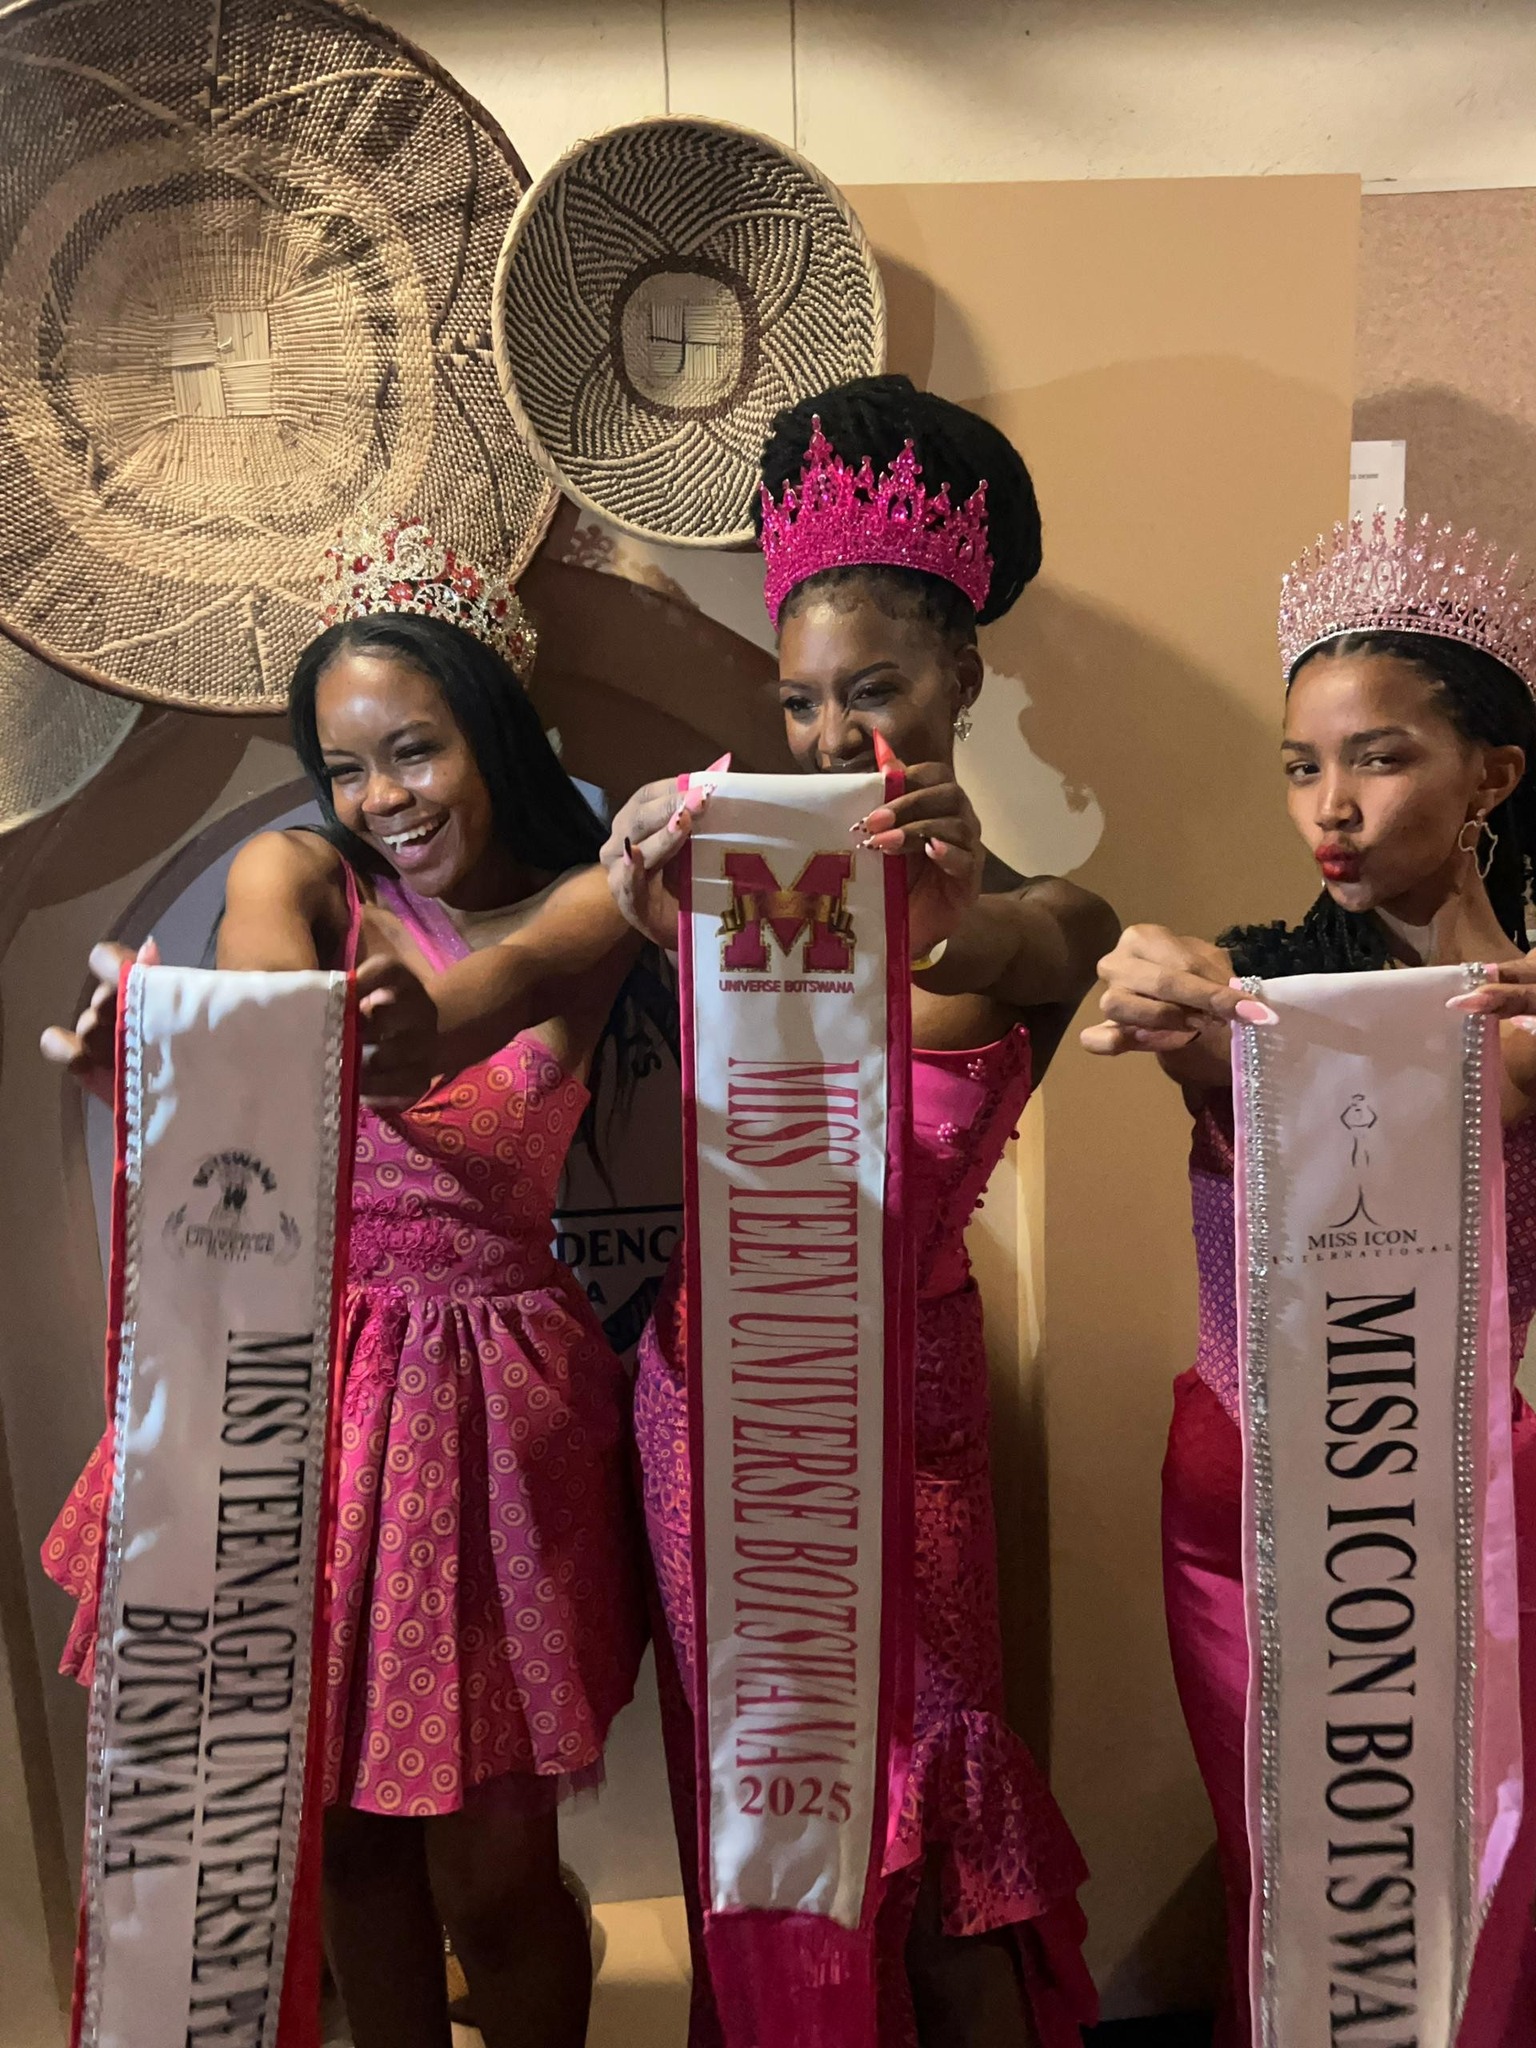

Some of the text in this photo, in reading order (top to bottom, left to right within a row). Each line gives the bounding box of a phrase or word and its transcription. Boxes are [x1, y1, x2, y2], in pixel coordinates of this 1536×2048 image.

[718, 979, 855, 994] UNIVERSE BOTSWANA
[557, 1225, 678, 1268] DENC
[1272, 1243, 1454, 1265] INTERNATIONAL
[1307, 1229, 1418, 1251] MISS ICON
[220, 1330, 315, 1447] MISS
[725, 1057, 861, 1770] MISS TEEN UNIVERSE BOTSWANA
[207, 1457, 306, 1720] TEENAGER
[1324, 1287, 1419, 2048] MISS ICON BOTSWA
[104, 1604, 210, 1879] BOTSWANA
[738, 1775, 853, 1825] 2025
[191, 1732, 292, 1982] UNIVERSE
